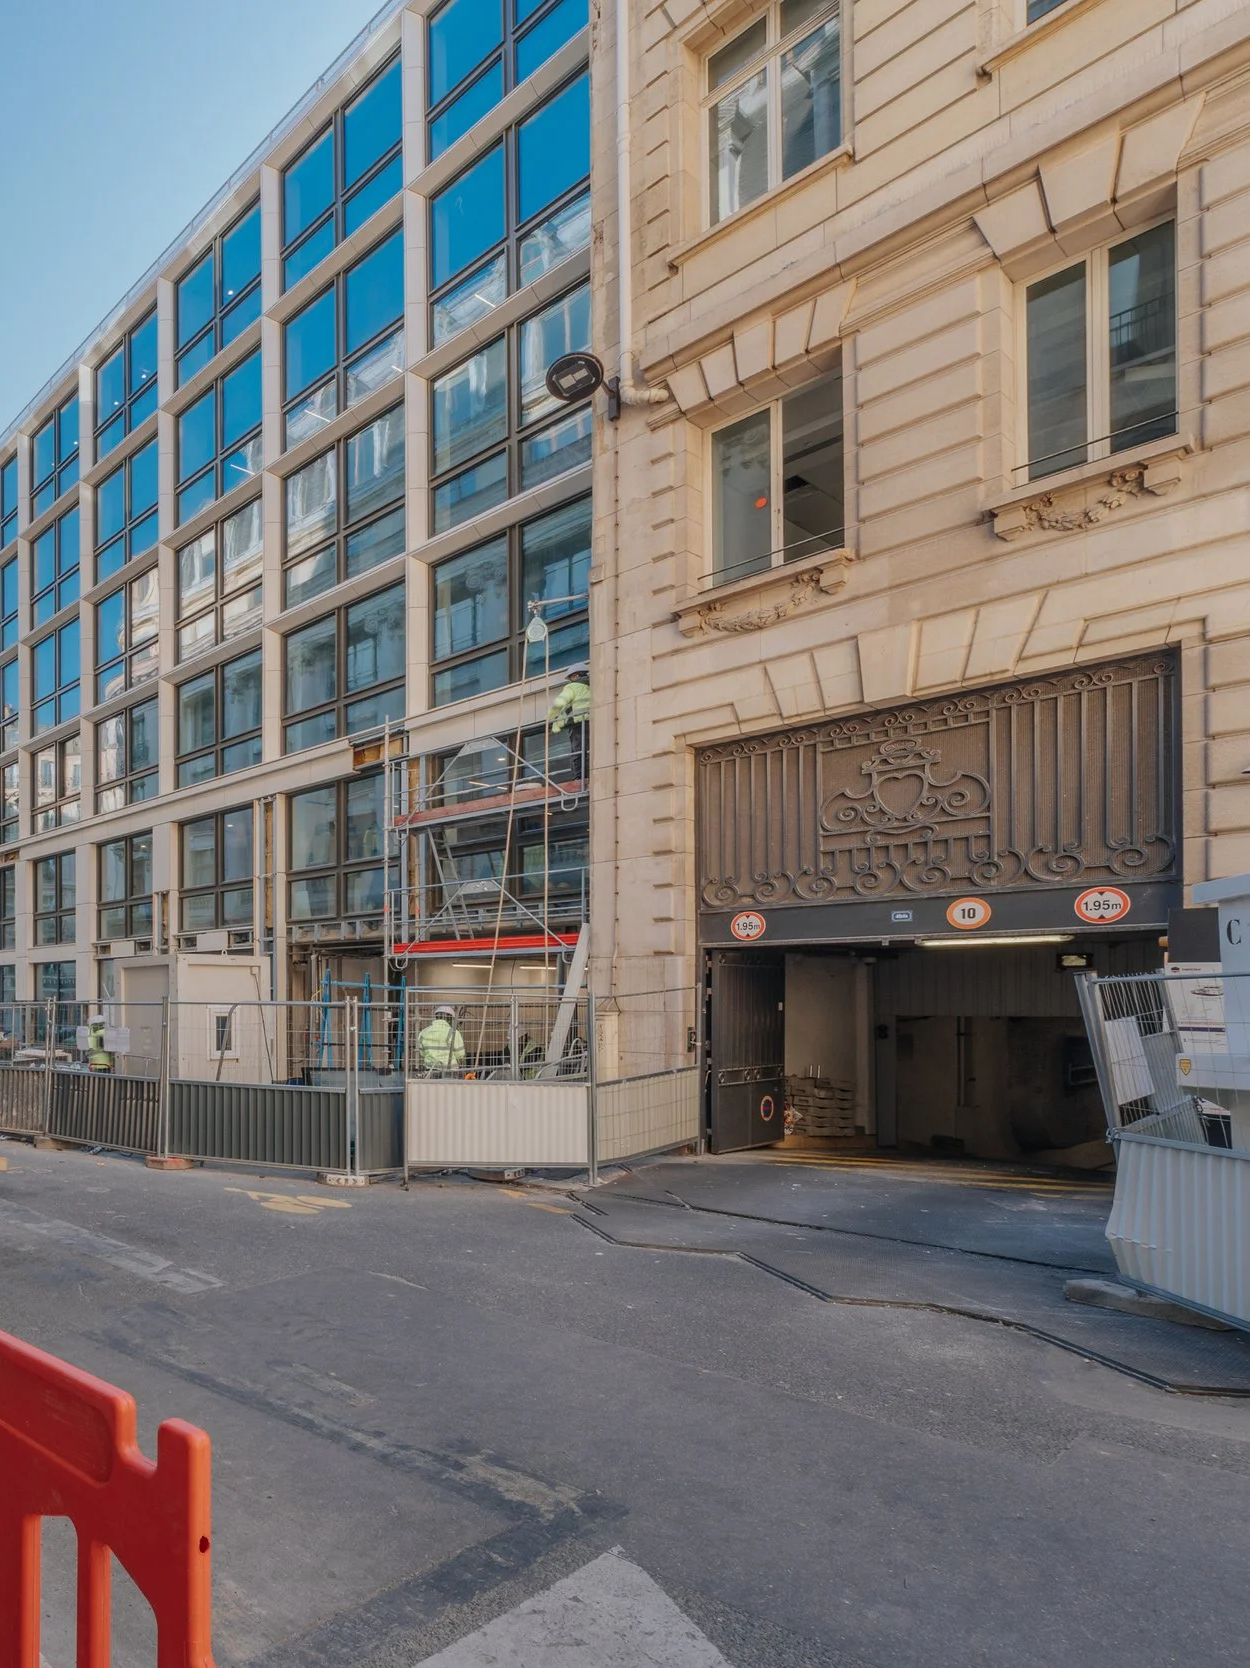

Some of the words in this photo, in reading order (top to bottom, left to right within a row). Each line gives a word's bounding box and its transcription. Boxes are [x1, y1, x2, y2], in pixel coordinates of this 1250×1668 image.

[1083, 900, 1121, 911] 1.95m
[960, 907, 976, 919] 10
[736, 921, 760, 931] 1.95m
